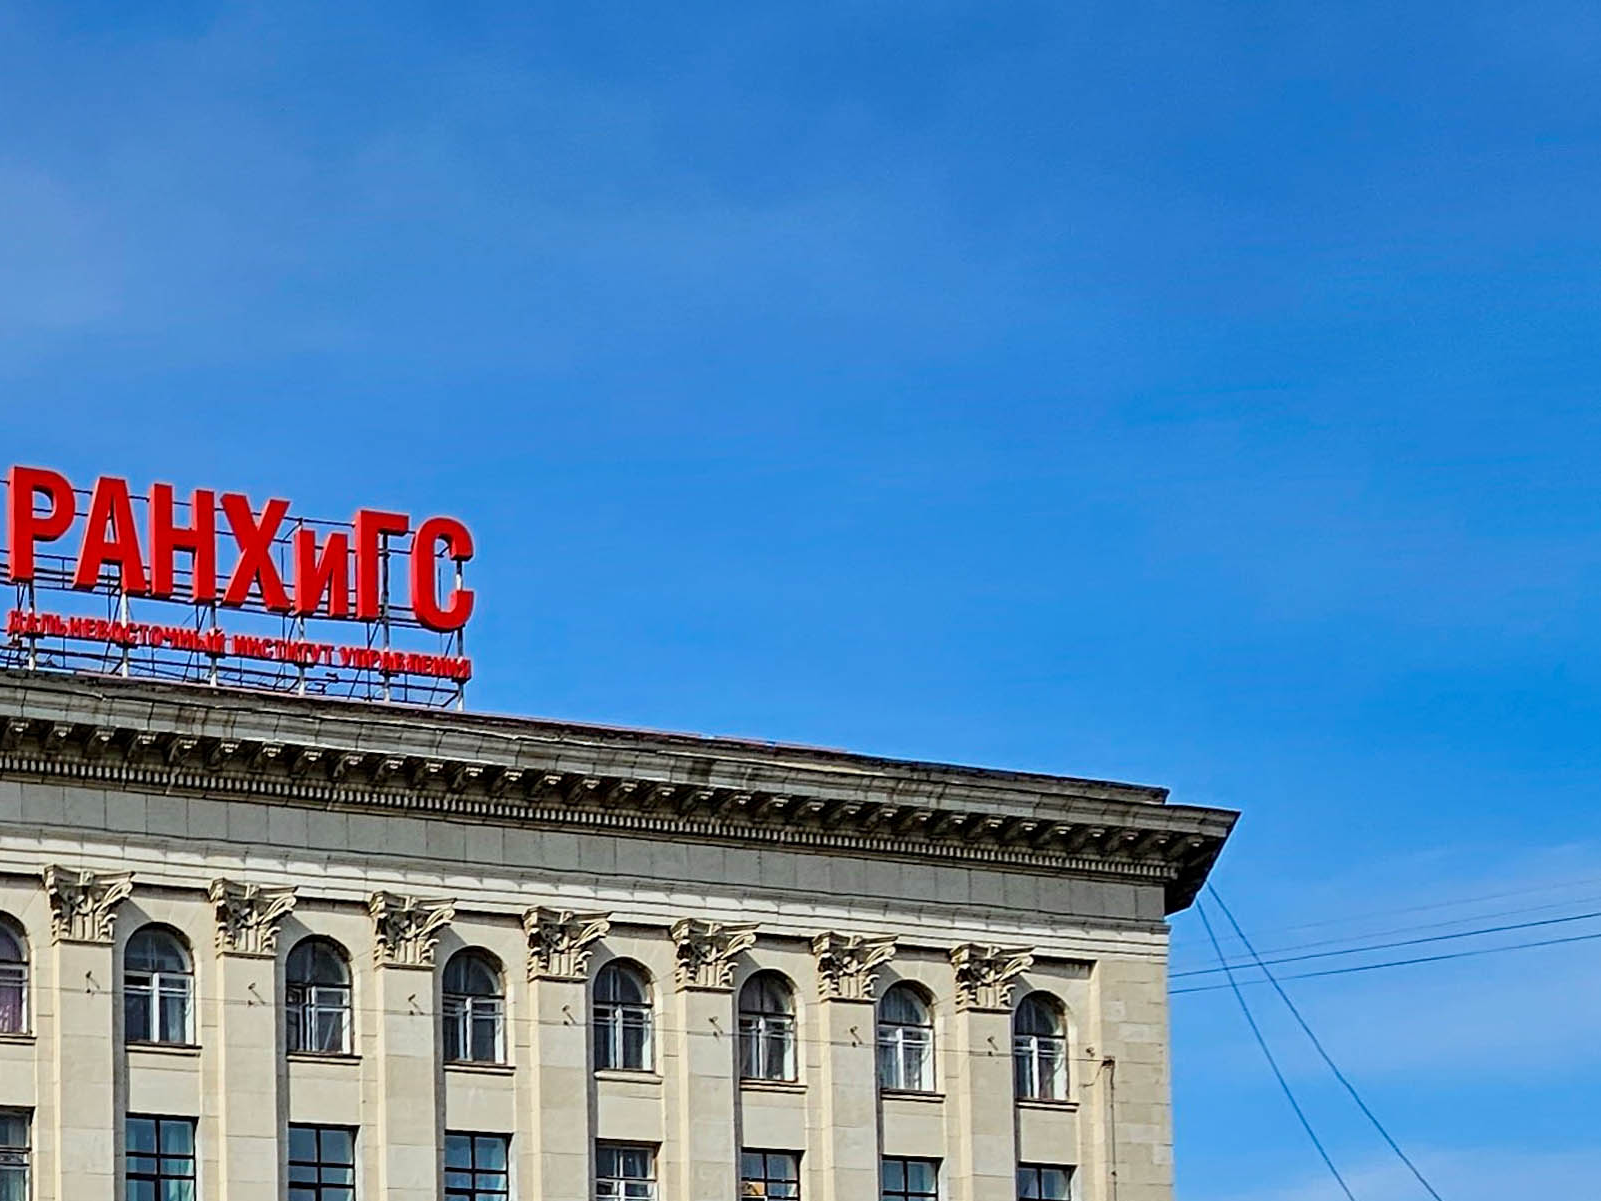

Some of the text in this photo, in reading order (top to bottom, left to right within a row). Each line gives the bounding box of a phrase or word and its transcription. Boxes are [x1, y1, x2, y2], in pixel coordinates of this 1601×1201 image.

[7, 464, 476, 633] РАНХиГС
[7, 610, 472, 679] ДАЛЬНЕВОСТОЧНЫЙ ИНСТИТУТ УПРАВЛЕНИЯ
